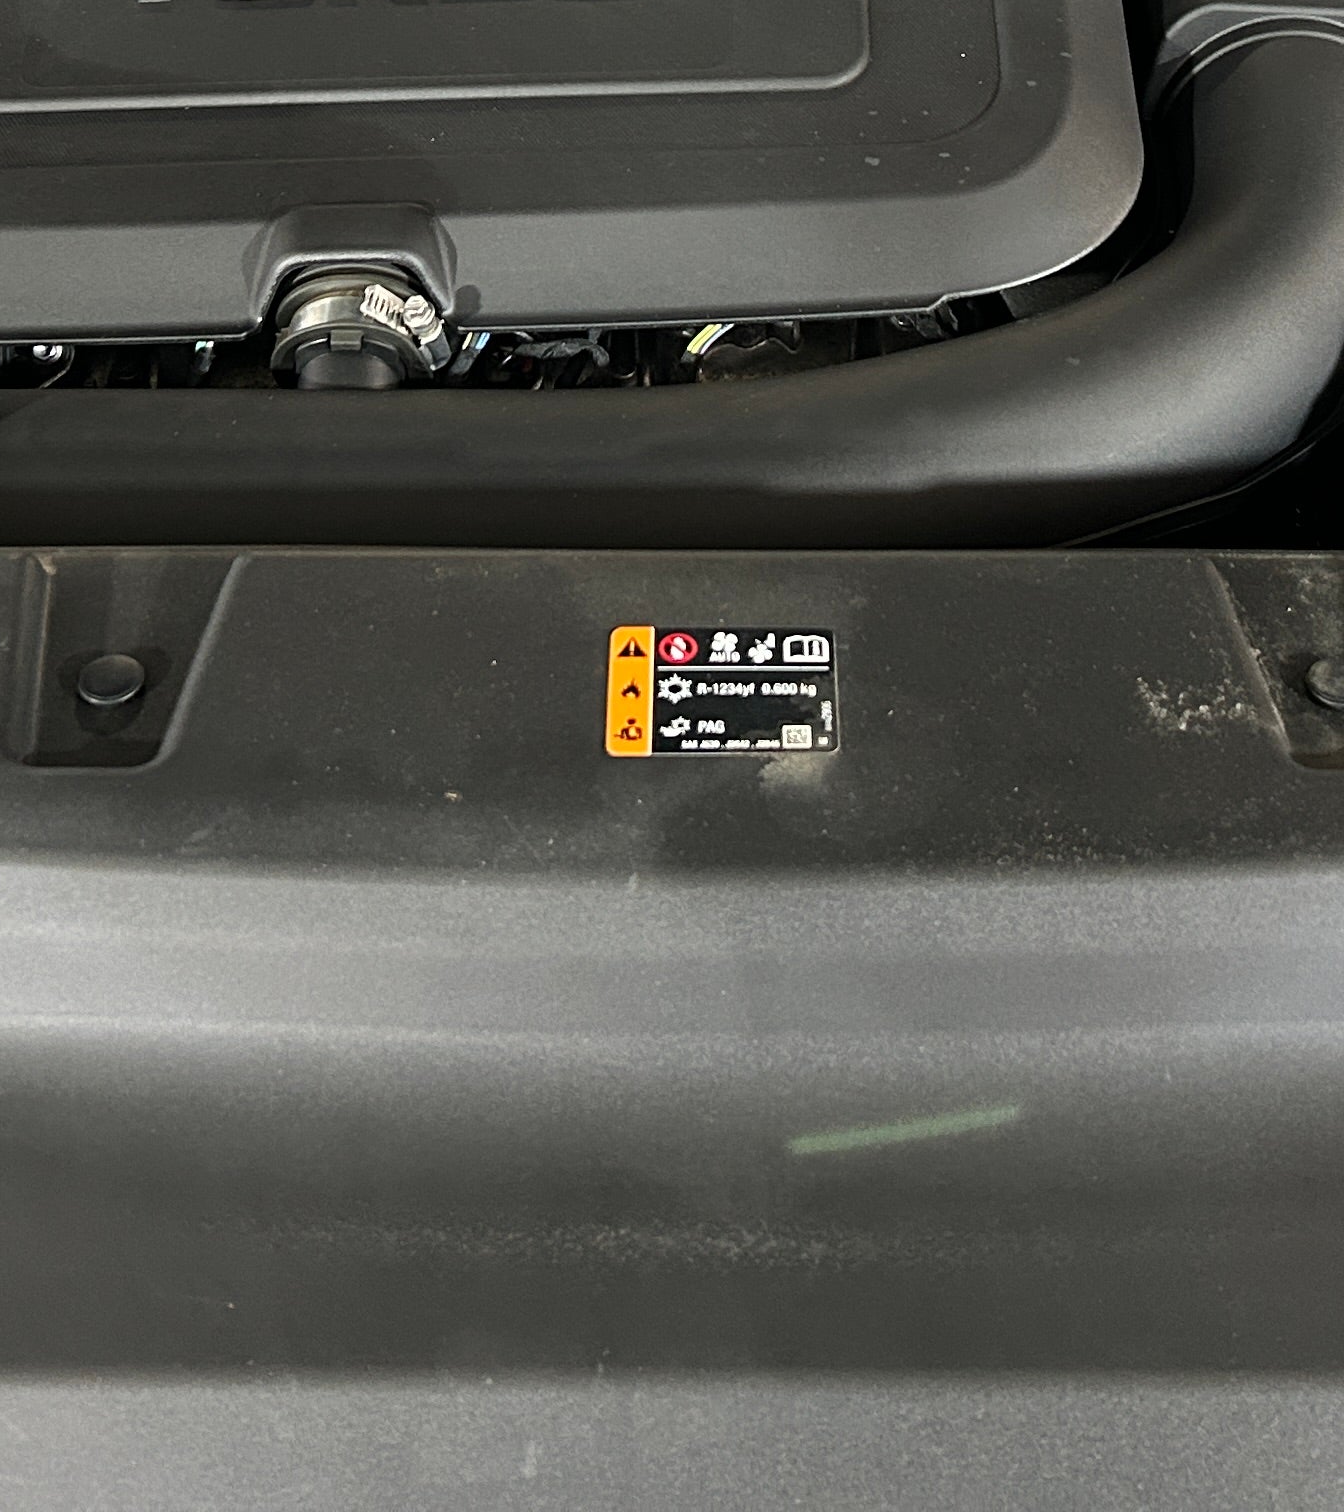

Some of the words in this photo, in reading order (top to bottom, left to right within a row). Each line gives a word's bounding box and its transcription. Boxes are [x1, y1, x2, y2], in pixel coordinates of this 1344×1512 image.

[696, 682, 755, 697] R-1234yf
[800, 682, 817, 697] kg
[697, 720, 726, 734] PAG
